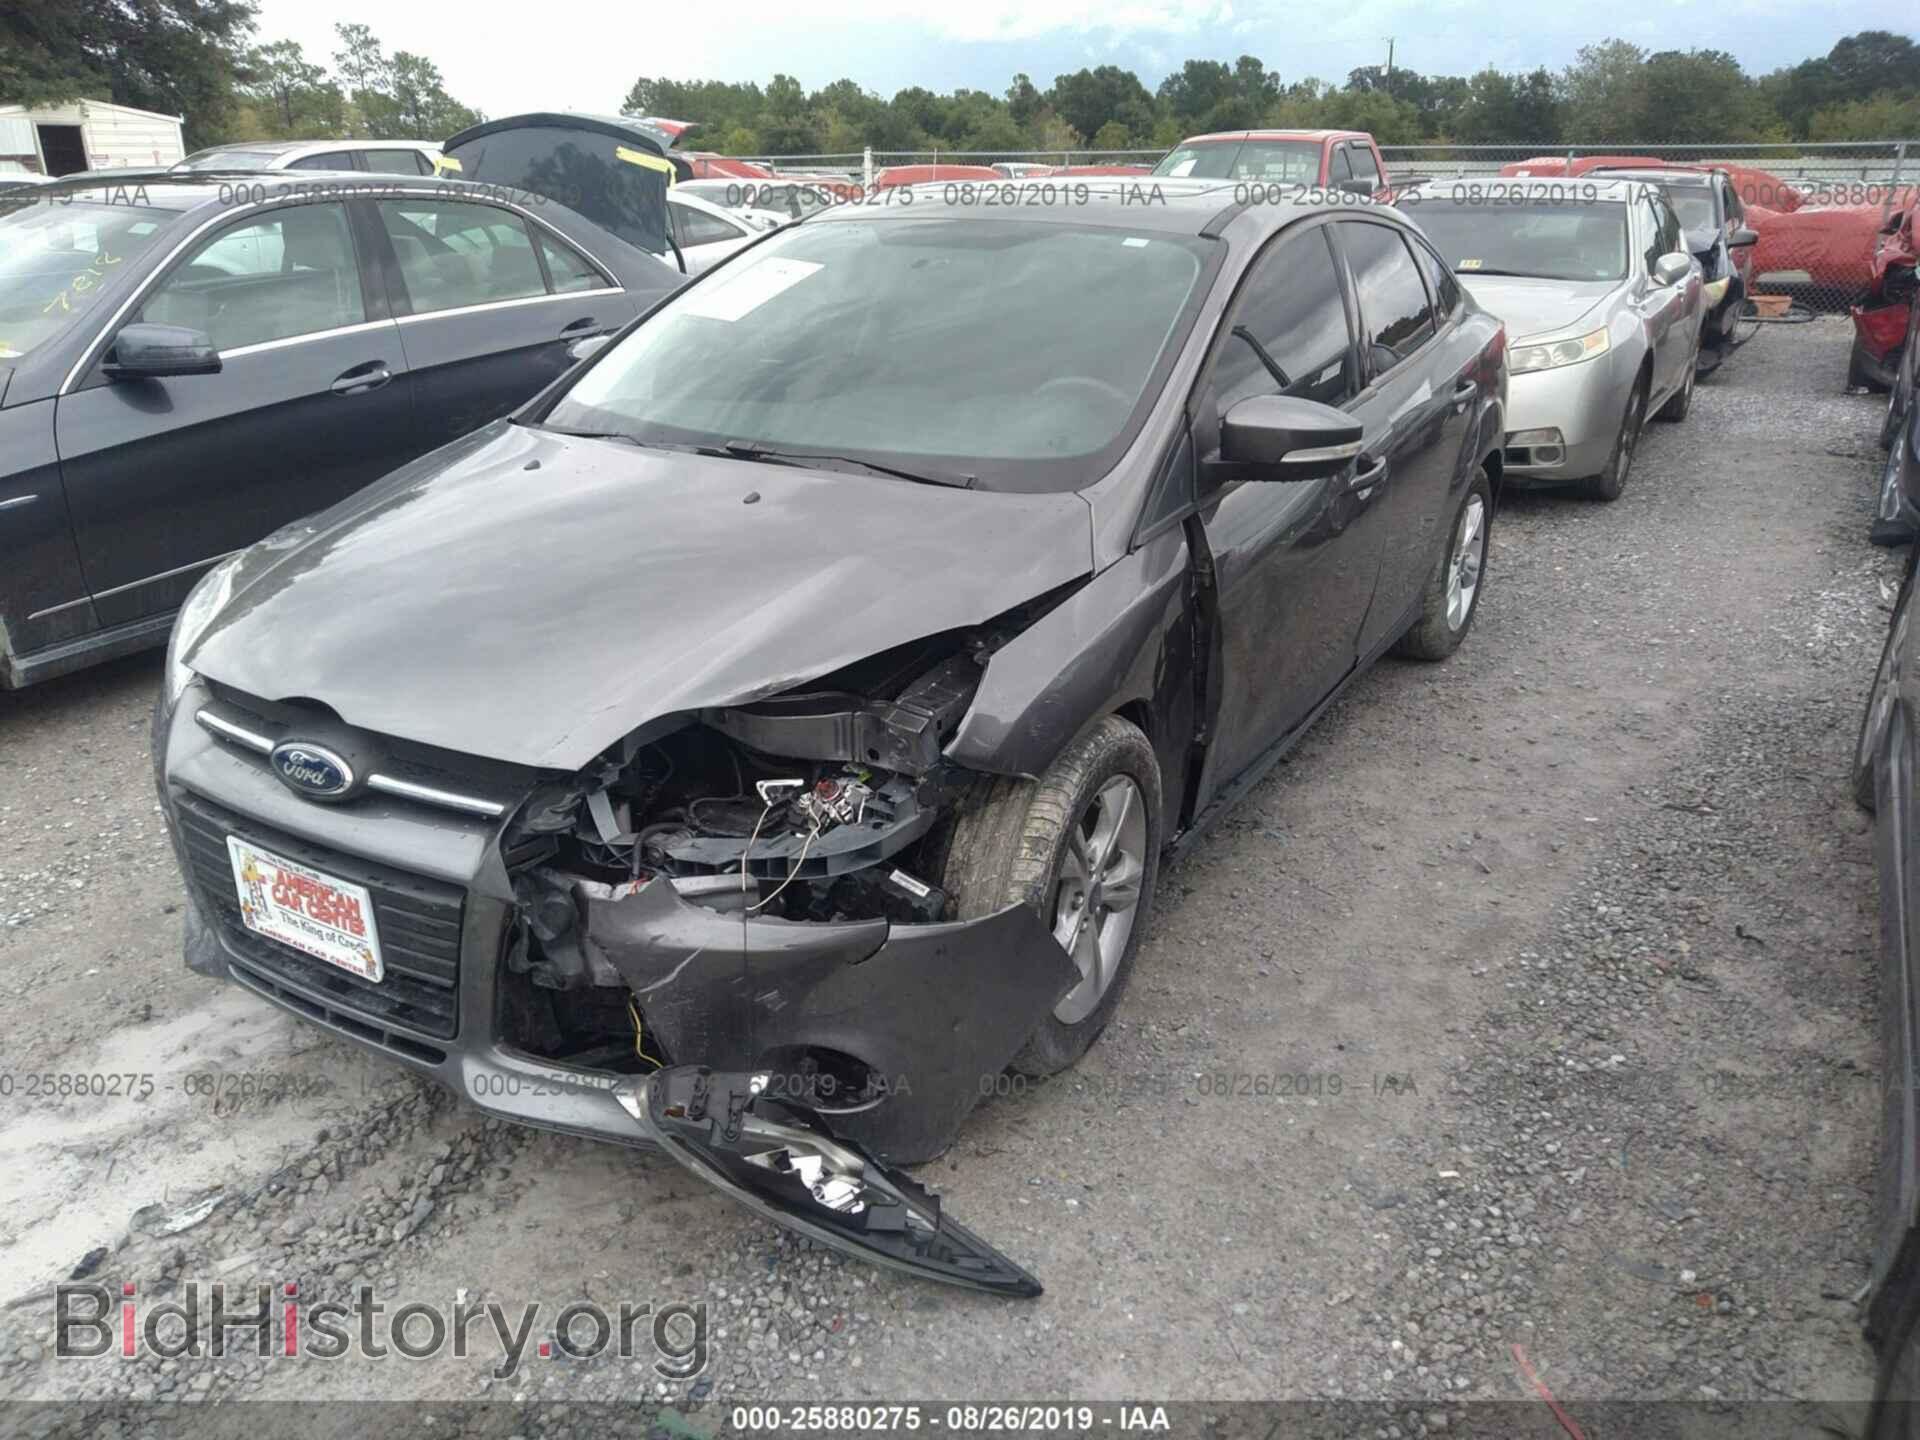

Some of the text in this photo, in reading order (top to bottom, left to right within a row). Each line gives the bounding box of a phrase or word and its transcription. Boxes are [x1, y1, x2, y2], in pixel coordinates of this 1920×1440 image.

[284, 750, 328, 785] Ford
[271, 884, 303, 914] CAR
[277, 868, 361, 921] AMERICAN
[259, 926, 305, 951] AMERICAN
[307, 945, 328, 959] CAR
[280, 911, 299, 928] The
[301, 920, 324, 942] King
[325, 932, 336, 943] of
